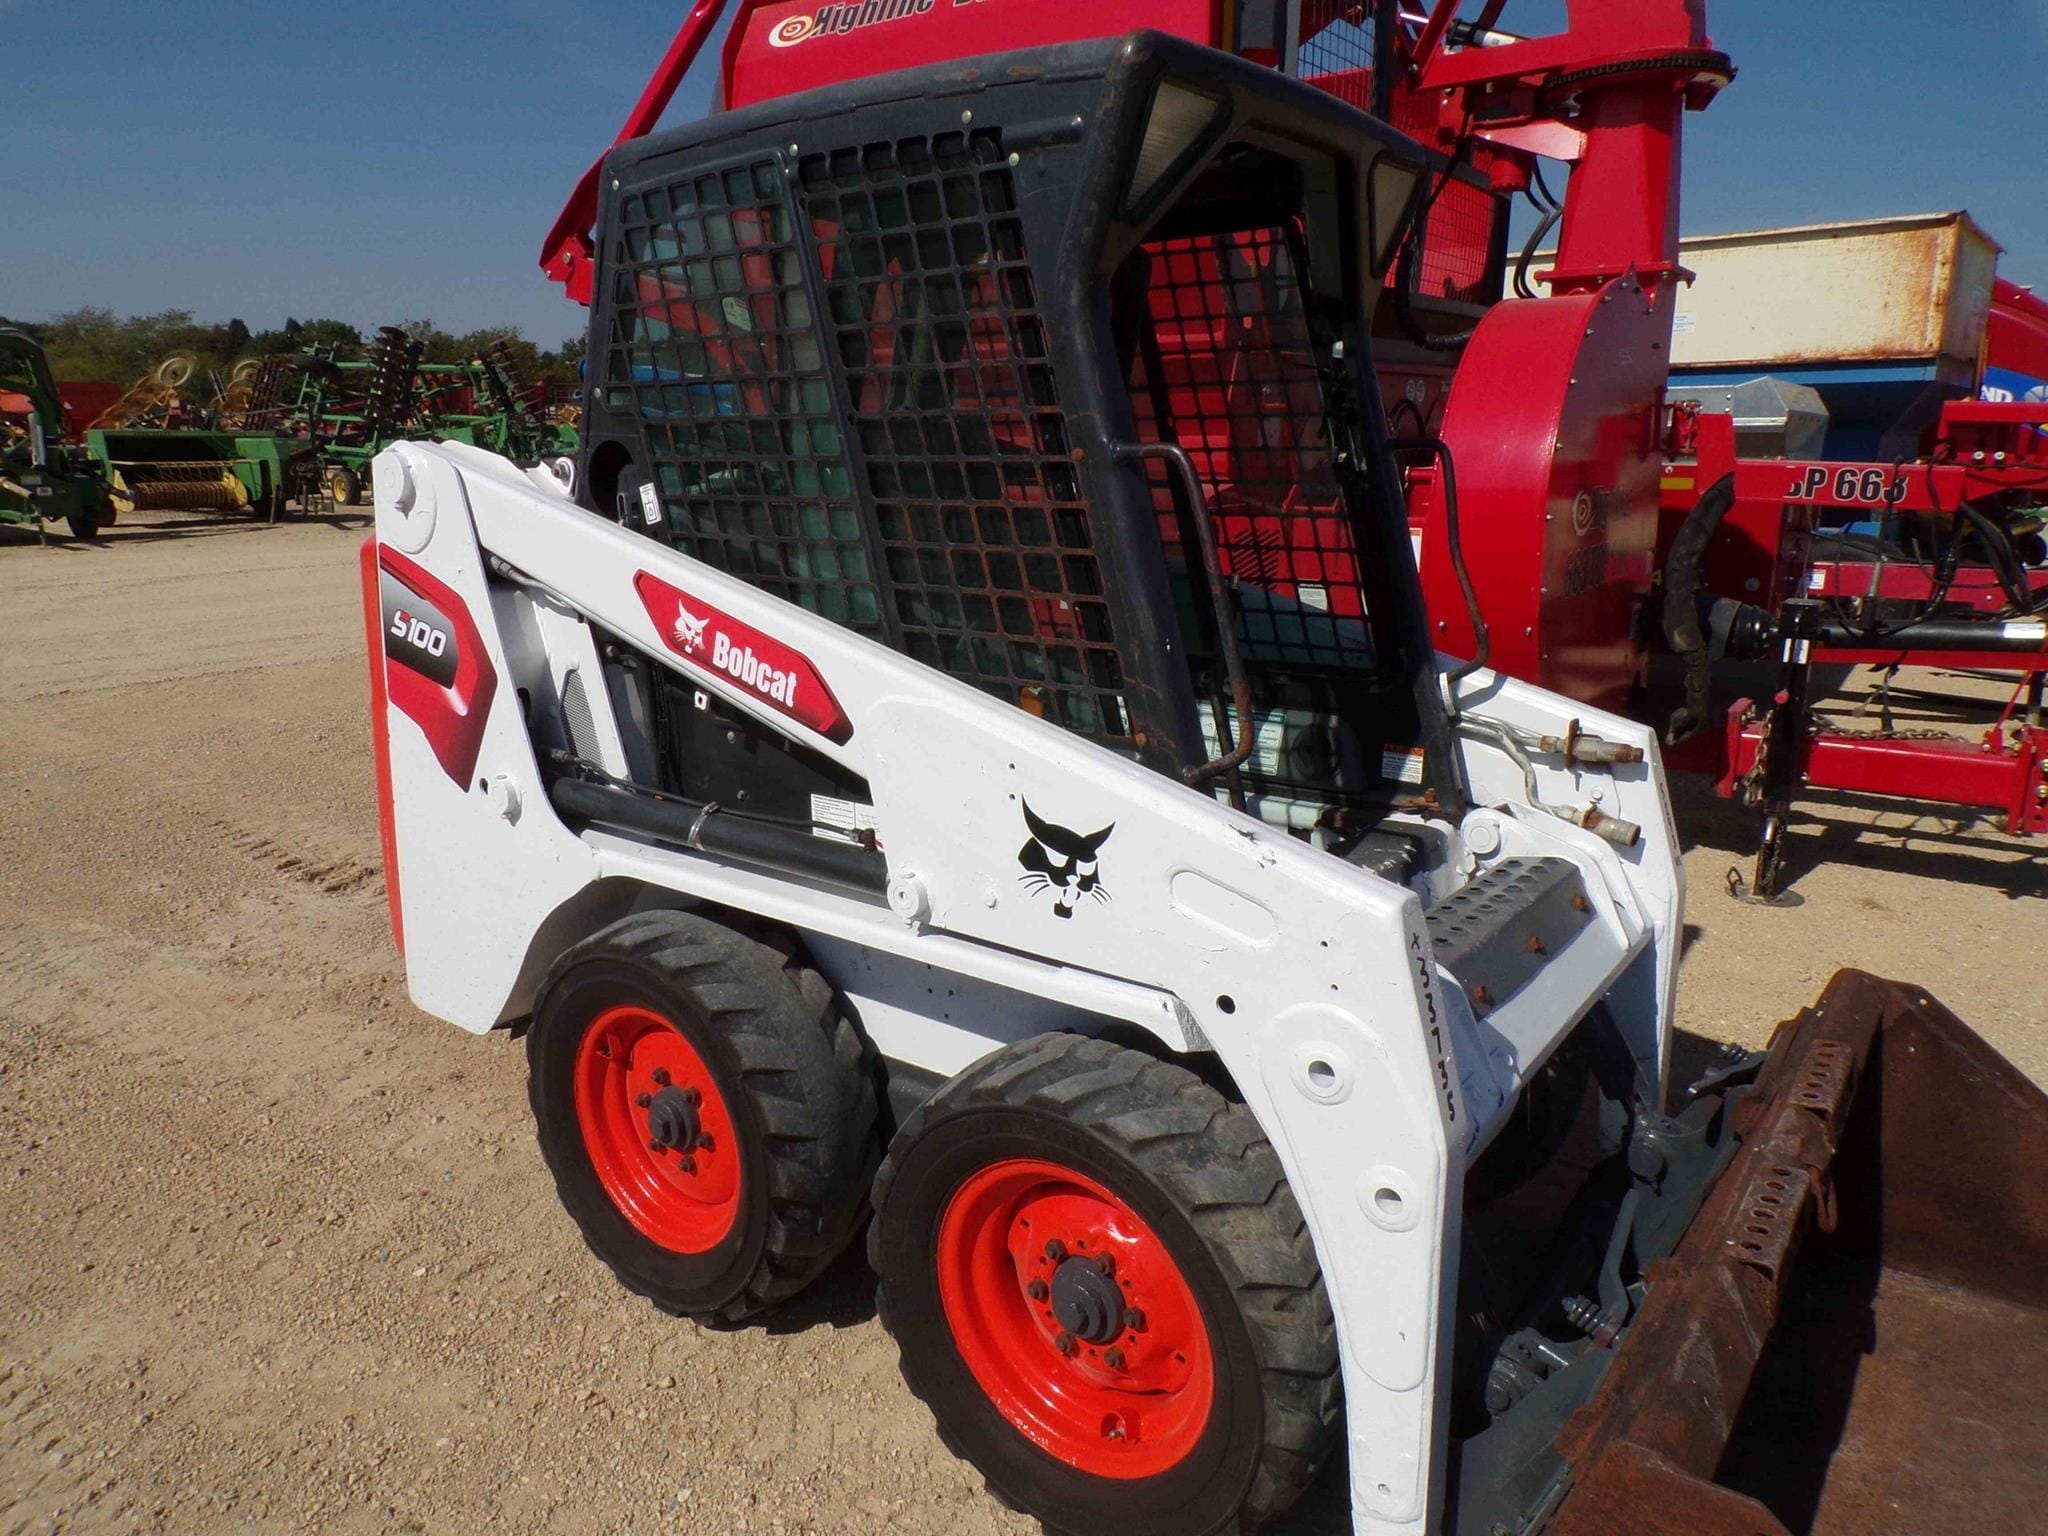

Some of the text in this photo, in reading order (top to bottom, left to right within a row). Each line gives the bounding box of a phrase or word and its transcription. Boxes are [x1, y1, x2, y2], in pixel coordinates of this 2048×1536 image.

[809, 0, 936, 38] Highline
[391, 610, 447, 657] S100
[712, 631, 797, 708] Bobcat
